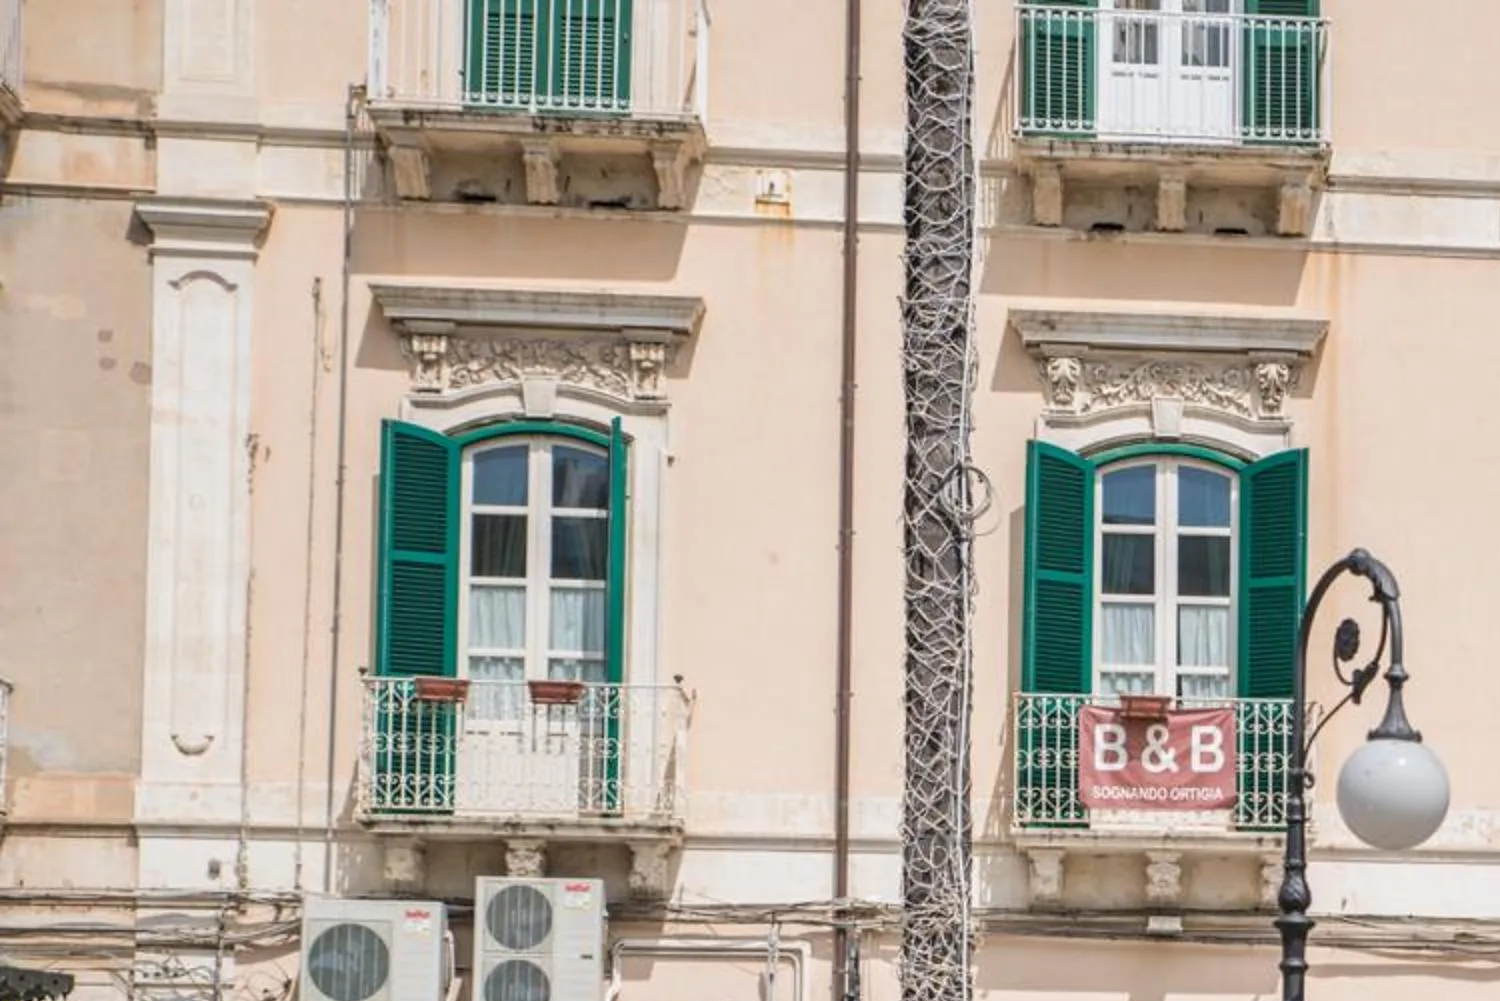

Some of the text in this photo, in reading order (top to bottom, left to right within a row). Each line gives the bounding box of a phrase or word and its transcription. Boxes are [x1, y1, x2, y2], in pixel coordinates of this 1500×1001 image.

[1093, 723, 1225, 773] B & B
[1091, 785, 1224, 801] SOGNANDO ORTIGIA
